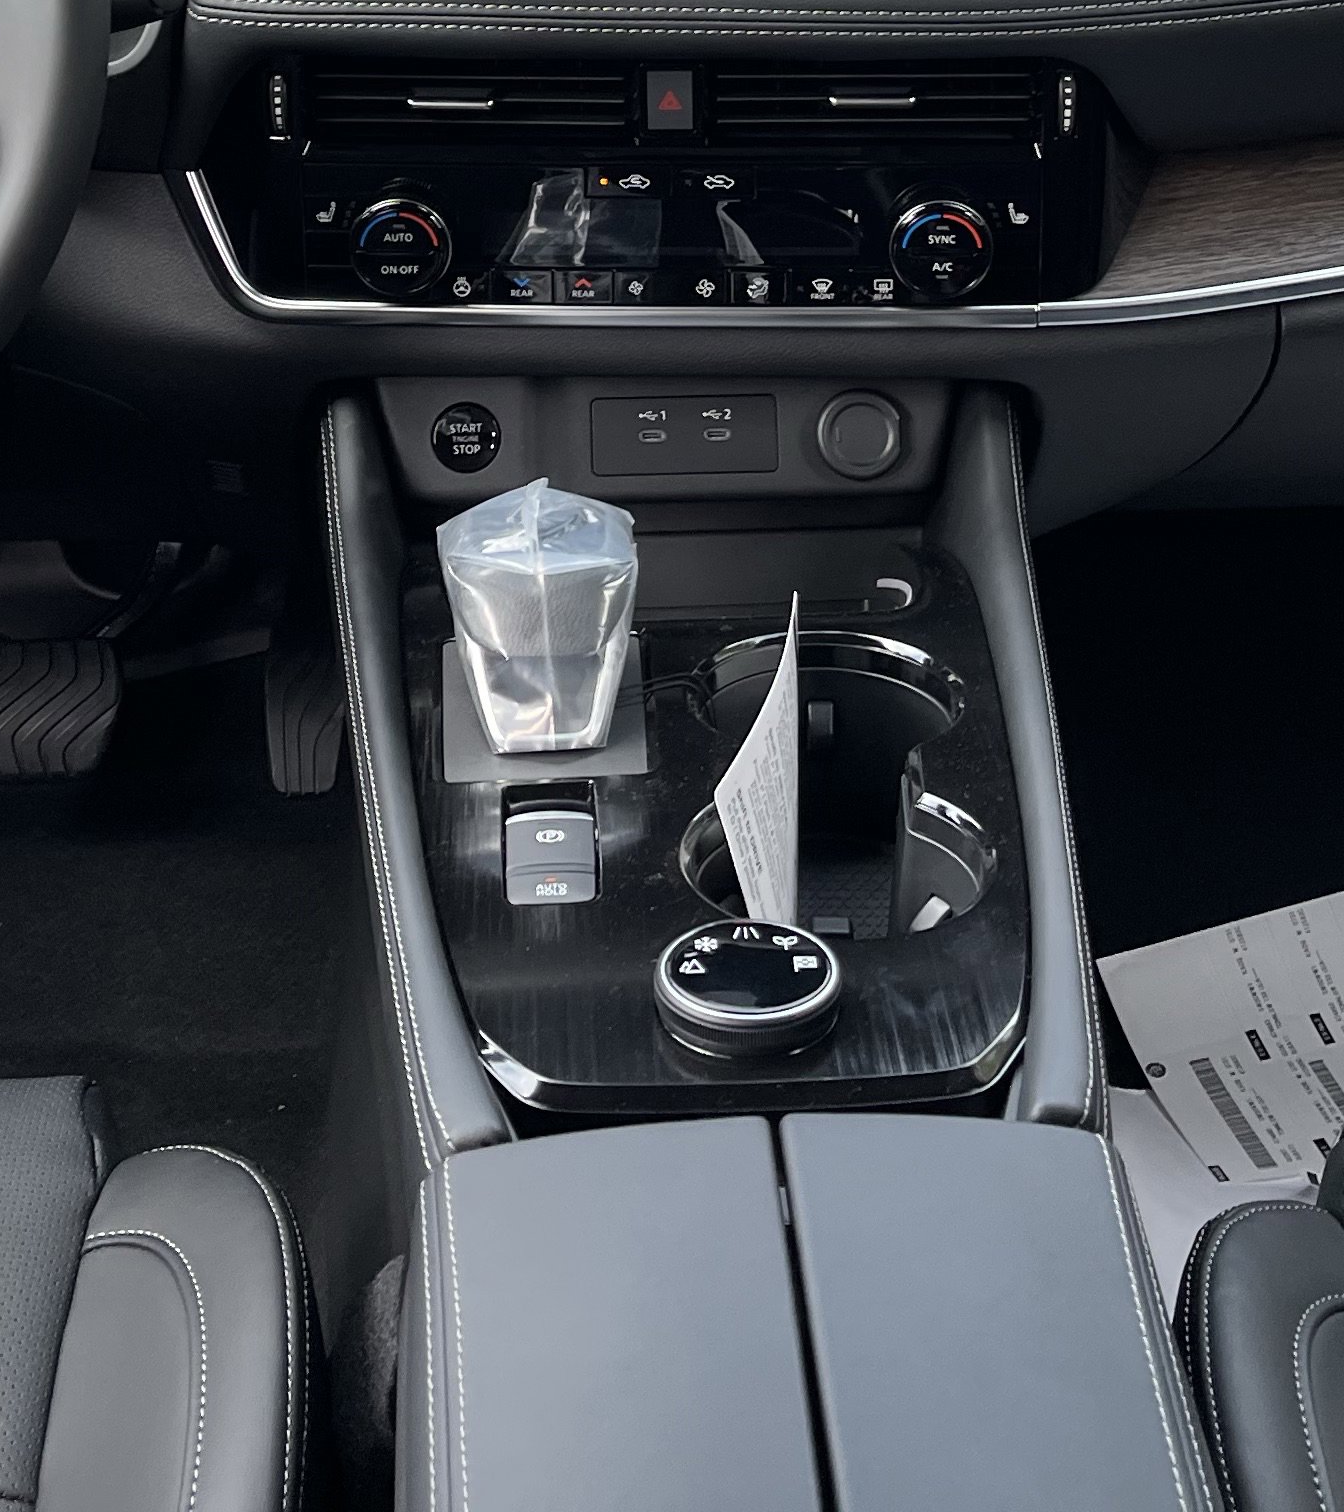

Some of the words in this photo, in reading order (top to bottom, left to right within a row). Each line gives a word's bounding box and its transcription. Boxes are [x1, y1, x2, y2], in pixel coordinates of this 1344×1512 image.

[383, 233, 413, 242] AUTO
[928, 235, 956, 245] SYNC
[932, 262, 953, 272] A/C
[510, 289, 534, 297] REAR
[572, 289, 595, 298] REAR
[659, 410, 667, 421] 1
[723, 408, 732, 420] 2
[449, 423, 482, 434] START
[453, 444, 481, 455] STOP
